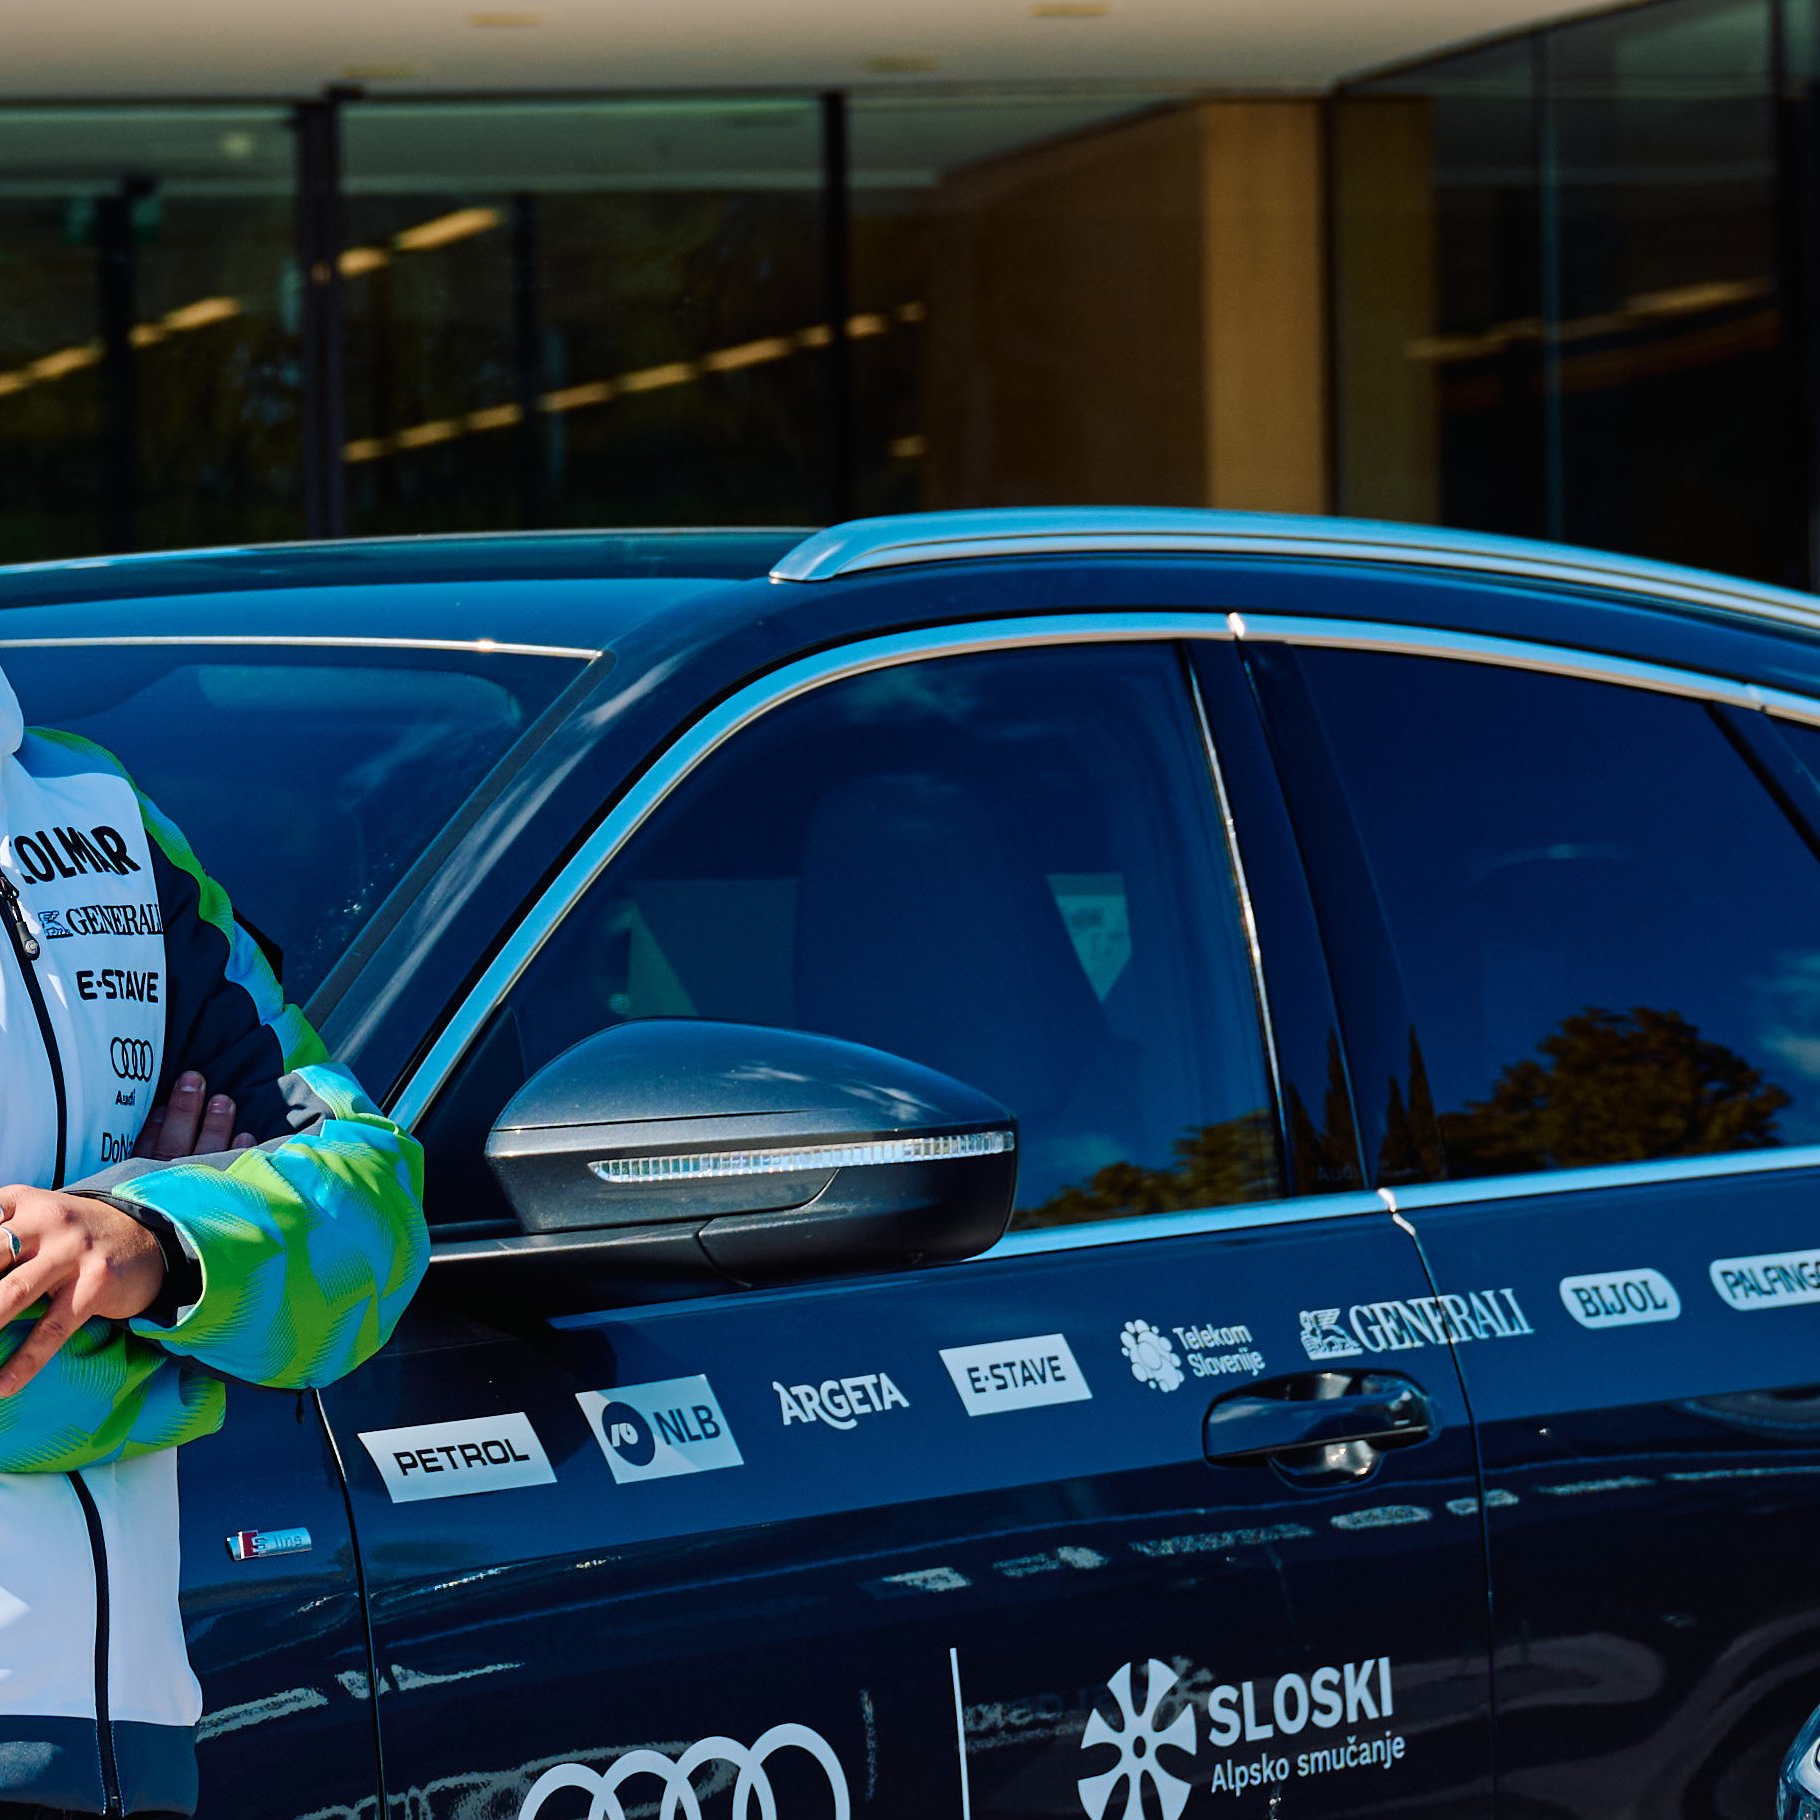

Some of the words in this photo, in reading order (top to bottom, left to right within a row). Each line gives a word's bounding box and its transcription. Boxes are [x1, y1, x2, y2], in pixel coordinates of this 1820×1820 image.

[9, 825, 142, 884] OLMAR
[115, 1088, 136, 1106] Audi
[101, 1132, 135, 1163] DoN
[1571, 1279, 1668, 1318] BIJOL
[1720, 1261, 1820, 1300] PALFING
[1172, 1323, 1253, 1350] Telekom
[1348, 1288, 1536, 1353] GENERALI
[1187, 1347, 1266, 1377] Slovenije
[772, 1372, 910, 1430] ARGETA
[653, 1404, 721, 1445] NLB
[394, 1438, 531, 1476] PETROL
[1208, 1656, 1394, 1747] SLOSKI
[1211, 1753, 1290, 1797] Alpsko
[1297, 1730, 1406, 1778] smučanje
